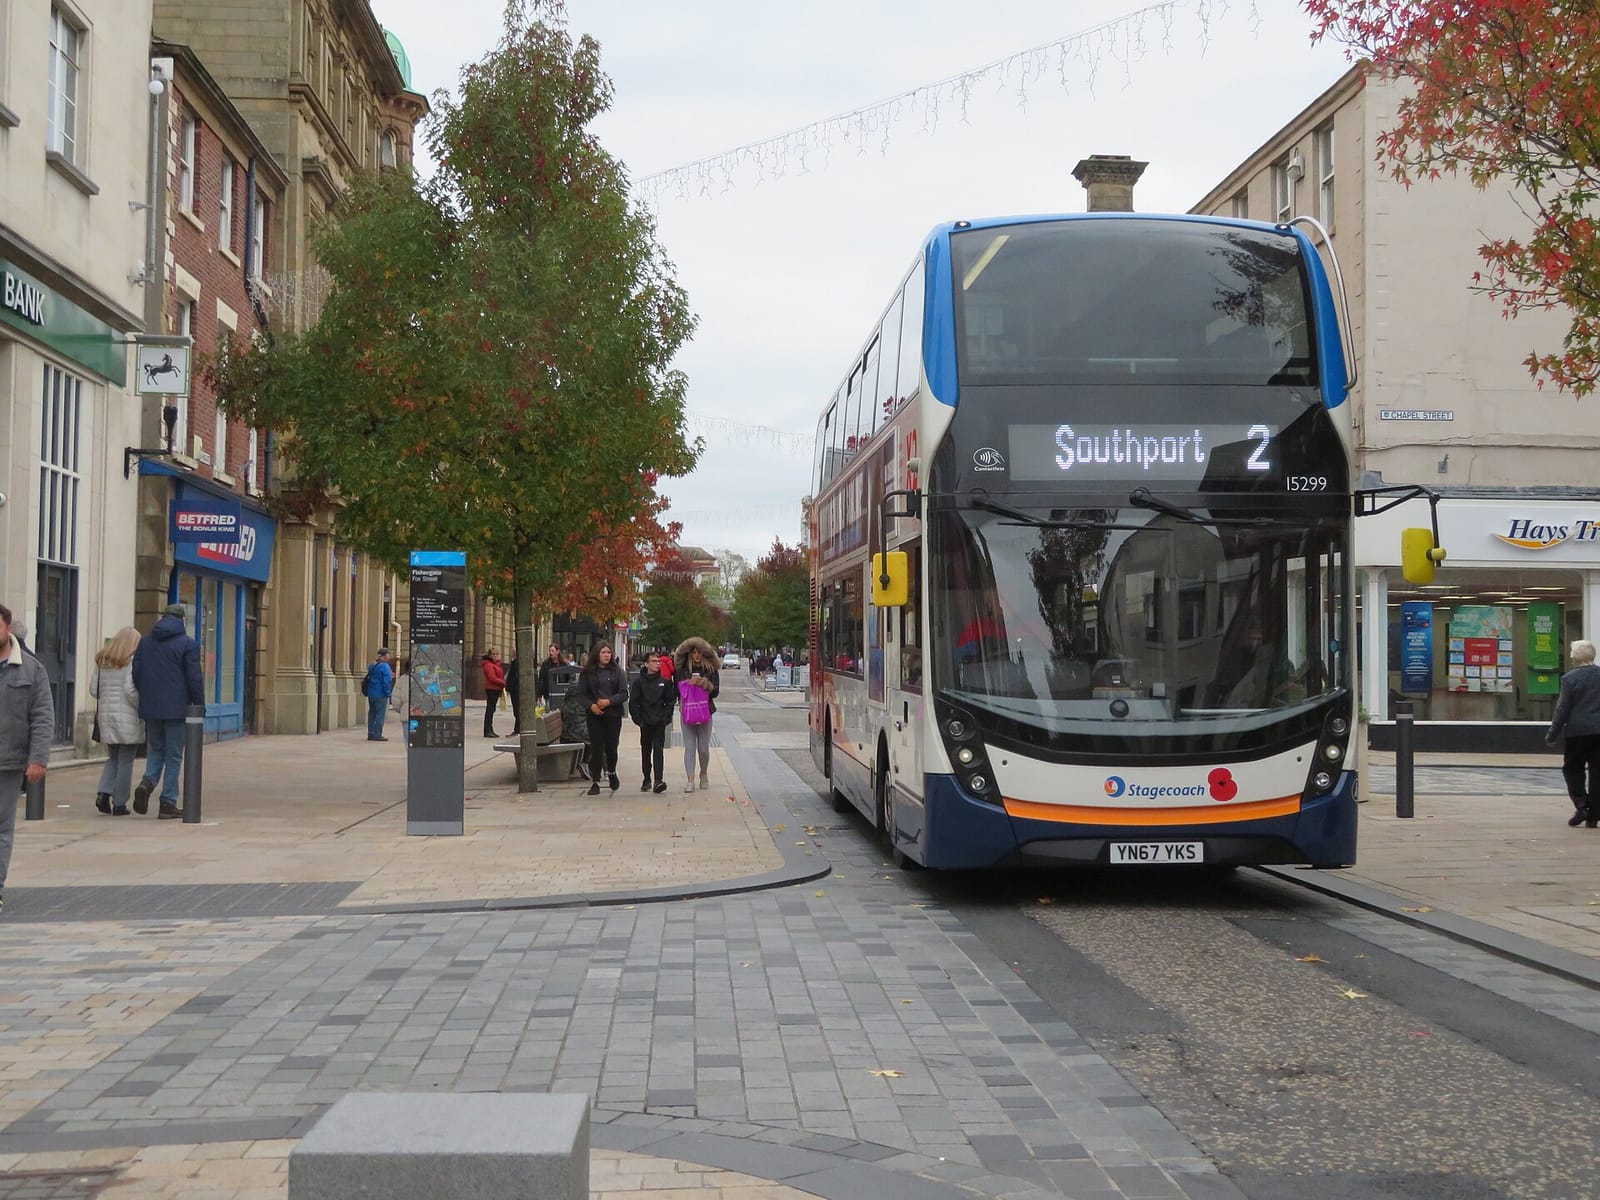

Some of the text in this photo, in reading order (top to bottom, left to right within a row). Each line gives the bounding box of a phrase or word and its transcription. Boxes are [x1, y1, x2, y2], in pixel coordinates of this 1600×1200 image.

[5, 271, 46, 326] BANK
[1391, 411, 1450, 420] CHAPEL STREET
[1055, 424, 1270, 470] Southport 2
[1286, 476, 1327, 491] 15299
[178, 514, 236, 525] BETFRED
[1508, 519, 1568, 544] Hays
[1128, 784, 1205, 800] Stagecoach
[1117, 844, 1196, 860] YN67 YKS
